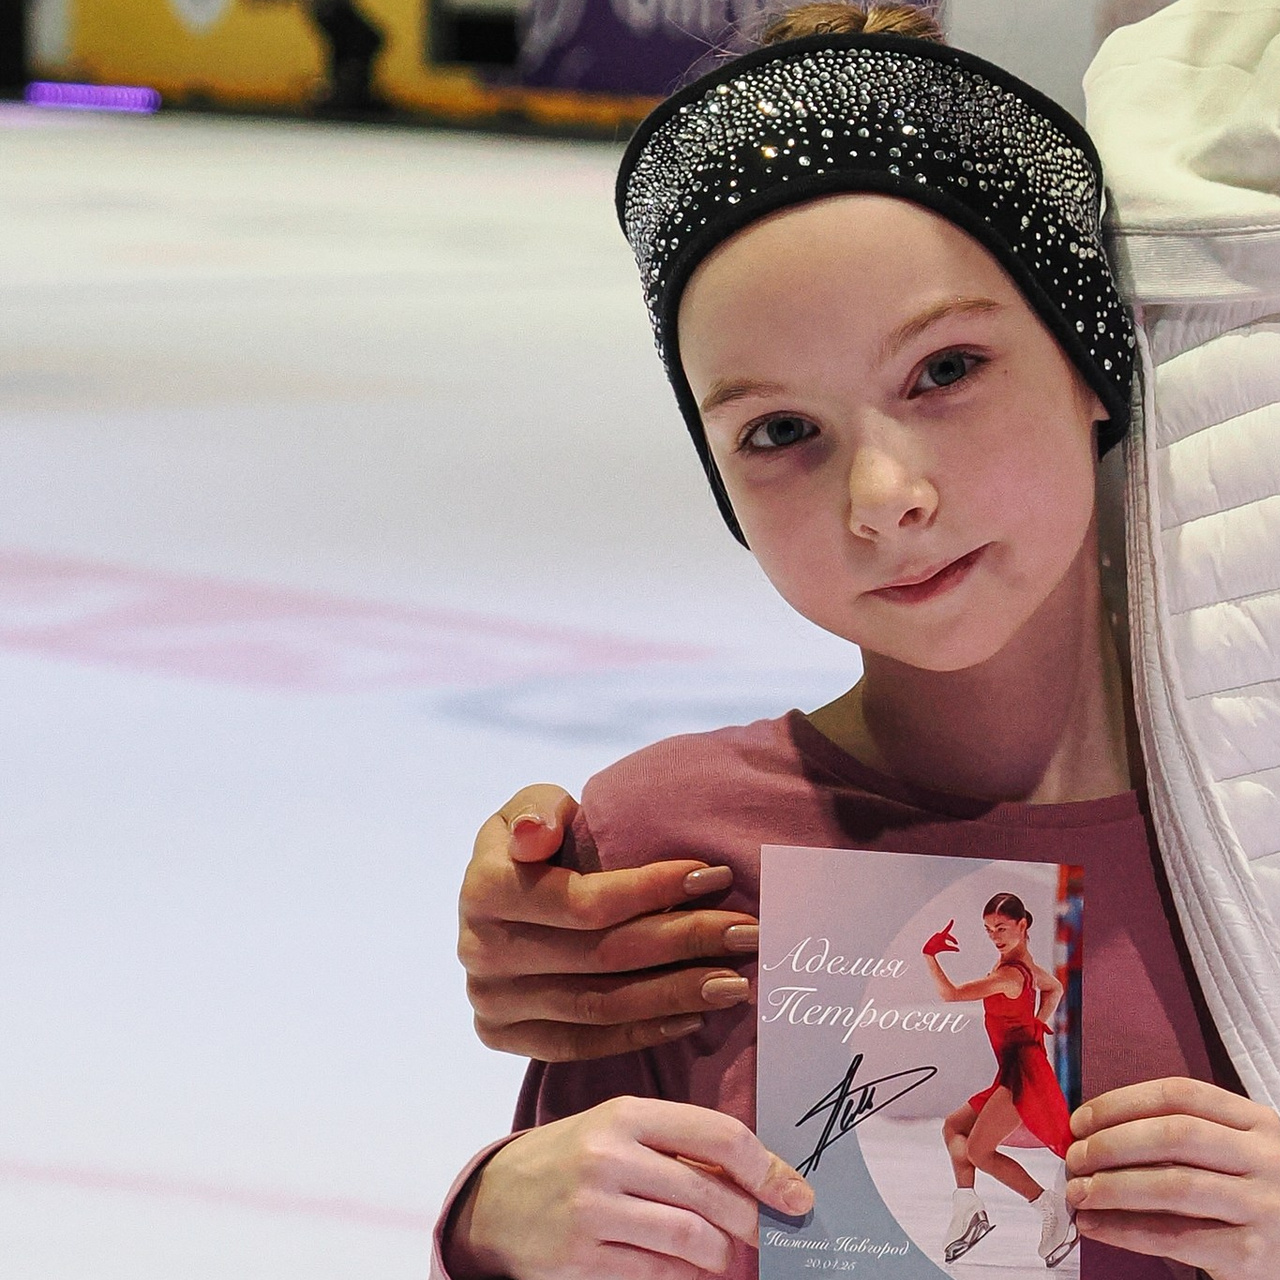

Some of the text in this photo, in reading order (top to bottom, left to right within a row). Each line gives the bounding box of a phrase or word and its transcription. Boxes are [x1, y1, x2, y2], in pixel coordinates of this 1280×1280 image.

[763, 936, 911, 979] Аделия
[761, 985, 971, 1044] Петросян
[764, 1230, 910, 1259] Нижний Новгород
